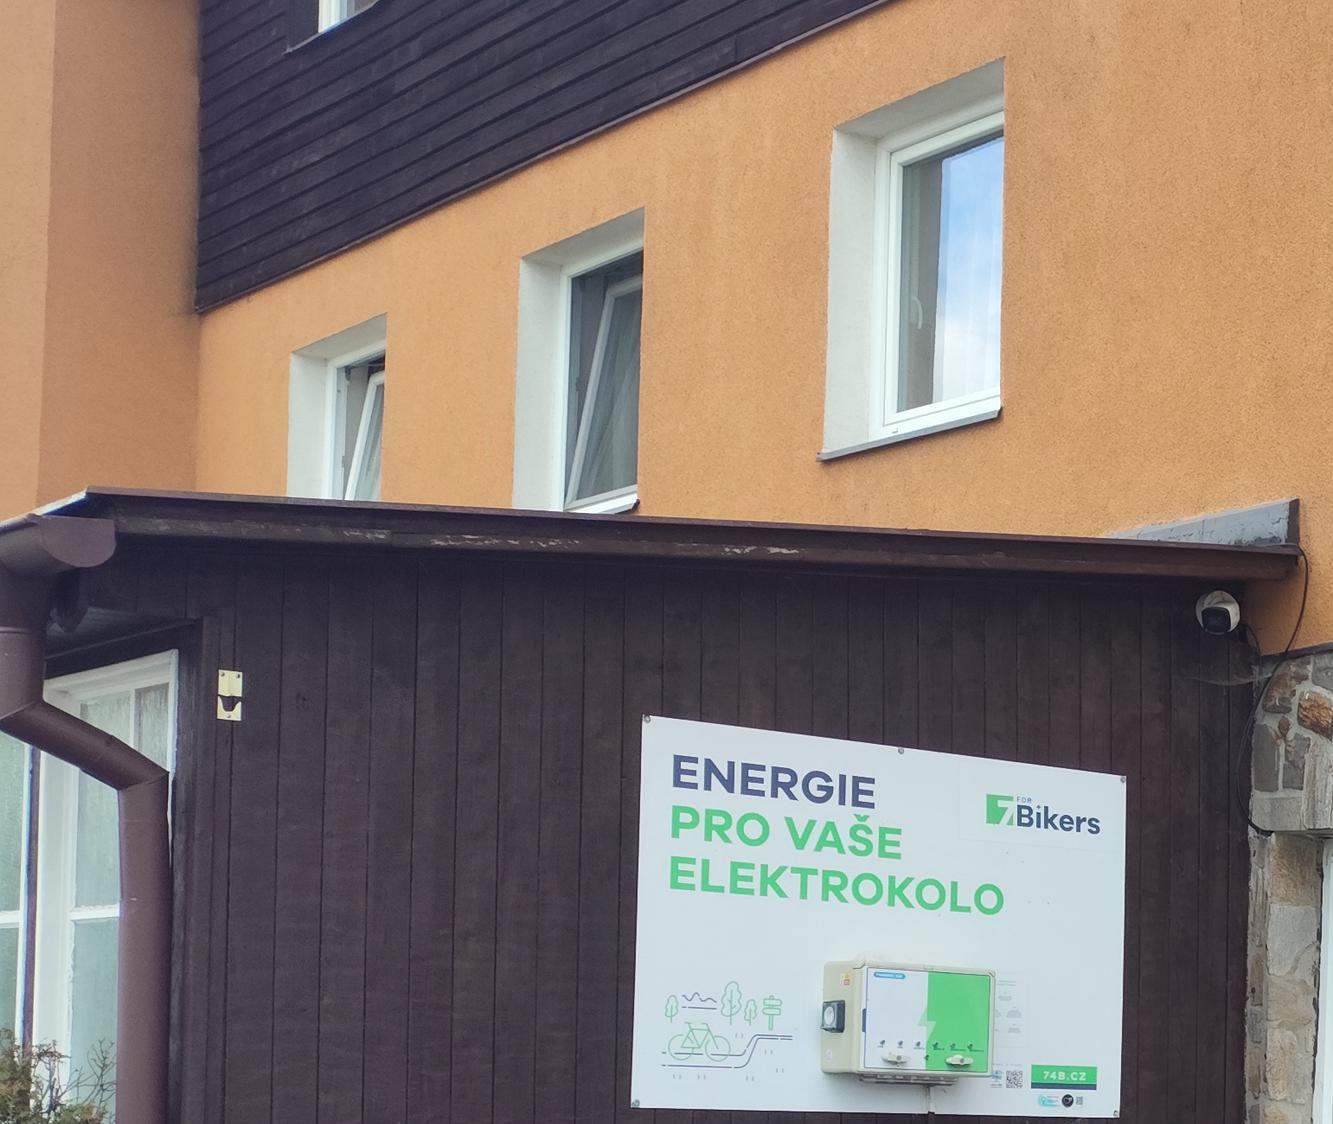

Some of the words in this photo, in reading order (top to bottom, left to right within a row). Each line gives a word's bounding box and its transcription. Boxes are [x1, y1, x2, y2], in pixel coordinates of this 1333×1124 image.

[672, 754, 876, 809] ENERGIE
[670, 805, 770, 847] PRO
[784, 813, 903, 860] VAŠE
[1016, 804, 1101, 835] Bikers
[669, 856, 1004, 916] ELEKTROKOLO
[1043, 1071, 1088, 1081] 74B.CZ
